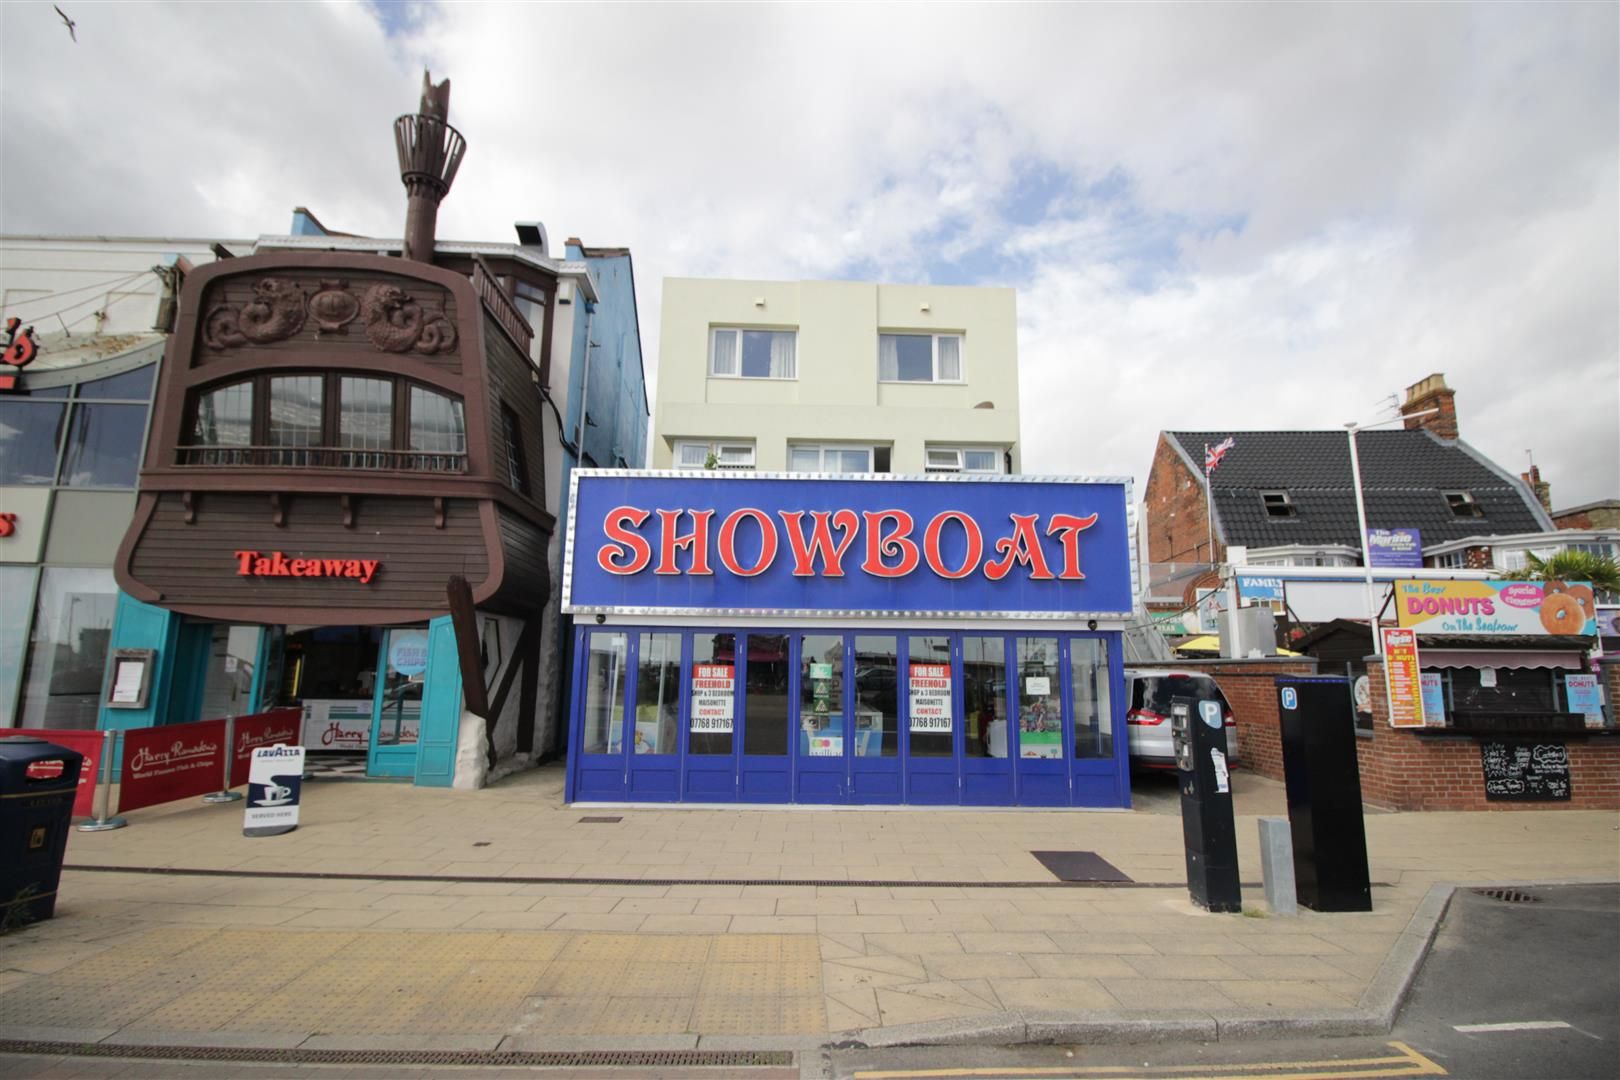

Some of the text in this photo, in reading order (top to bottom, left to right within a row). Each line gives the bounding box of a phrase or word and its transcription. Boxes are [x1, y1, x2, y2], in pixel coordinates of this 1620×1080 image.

[597, 506, 1099, 581] SHOWBOAT
[233, 551, 378, 583] Takeaway
[1407, 597, 1496, 615] DONUTS
[1456, 617, 1473, 631] The
[699, 667, 728, 677] FOR SALE
[914, 666, 944, 677] FOR SALE
[696, 680, 731, 688] FREEHOLD
[911, 680, 947, 688] FREEHOLD
[322, 722, 363, 746] Harry
[131, 747, 170, 771] Harry
[257, 747, 300, 757] LAVAZZA
